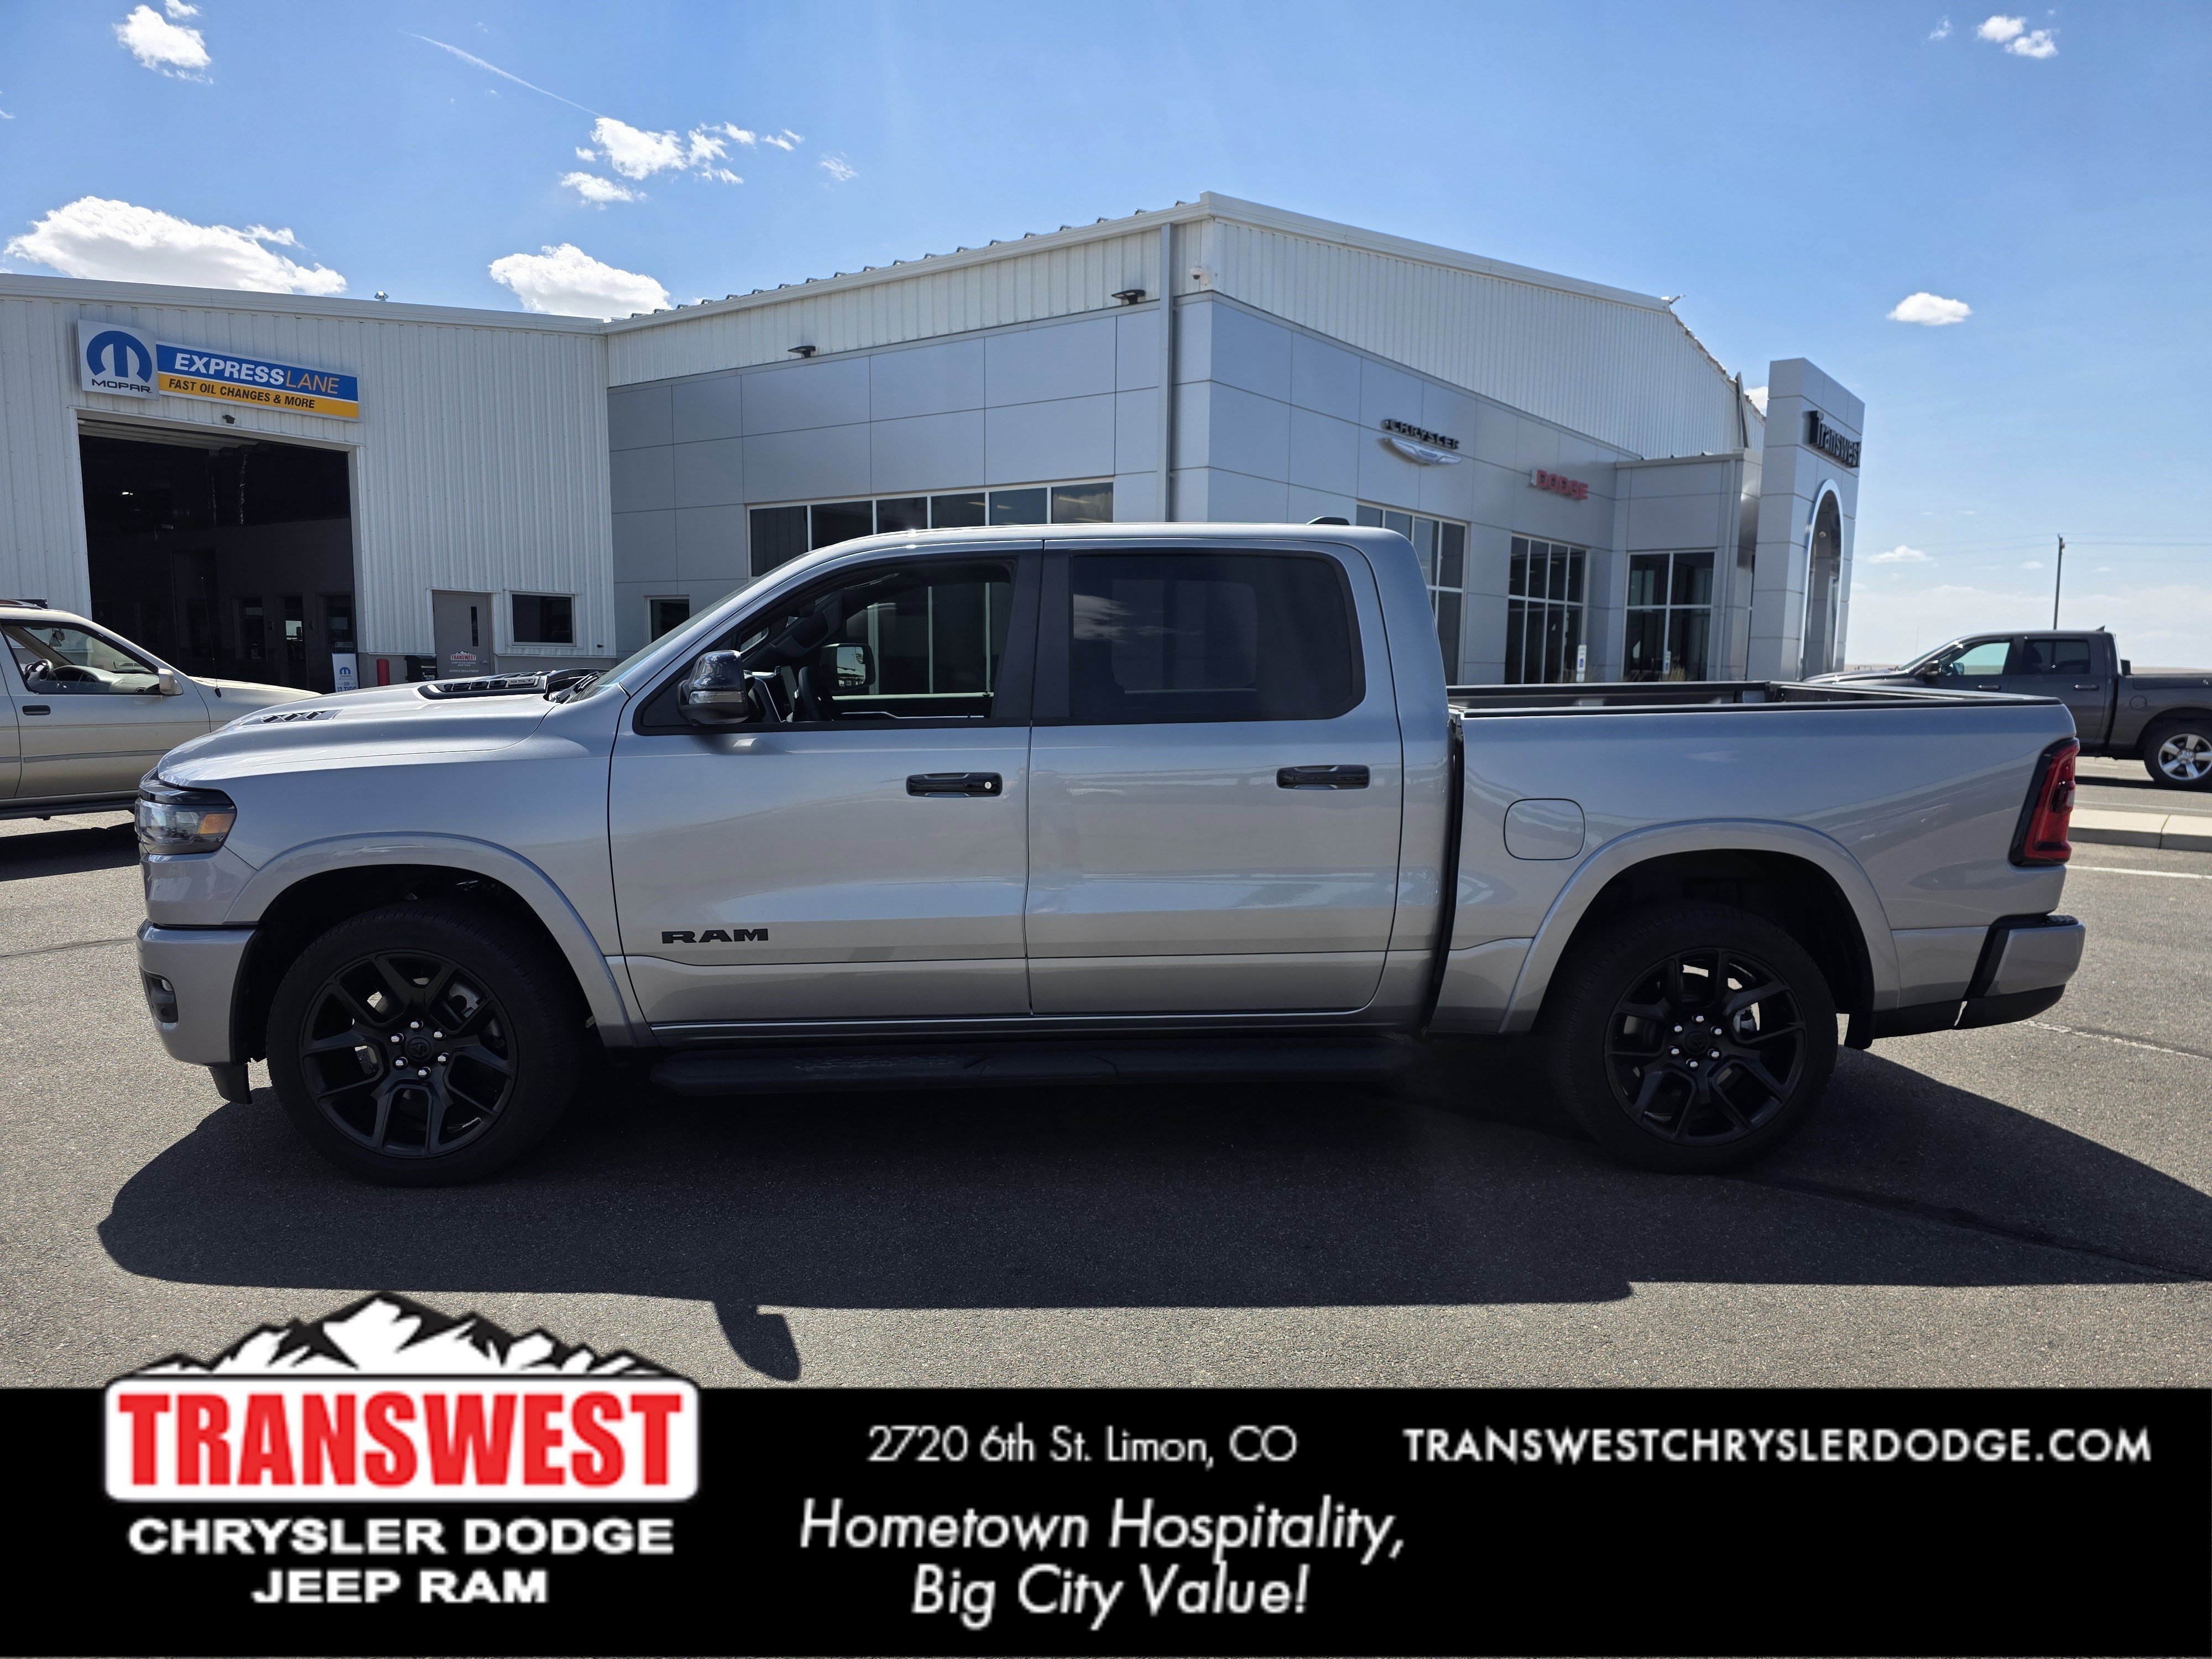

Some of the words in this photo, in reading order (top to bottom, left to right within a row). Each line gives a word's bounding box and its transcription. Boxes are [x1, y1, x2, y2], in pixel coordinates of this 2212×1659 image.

[91, 379, 152, 393] MOPAR
[169, 378, 197, 391] FAST
[200, 383, 216, 394] OIL
[220, 386, 270, 401] CHANGES
[273, 394, 281, 404] &
[284, 396, 316, 409] MORE
[1380, 419, 1460, 449] CHRYSLER
[1536, 469, 1589, 500] DODGE
[661, 928, 769, 944] RAM
